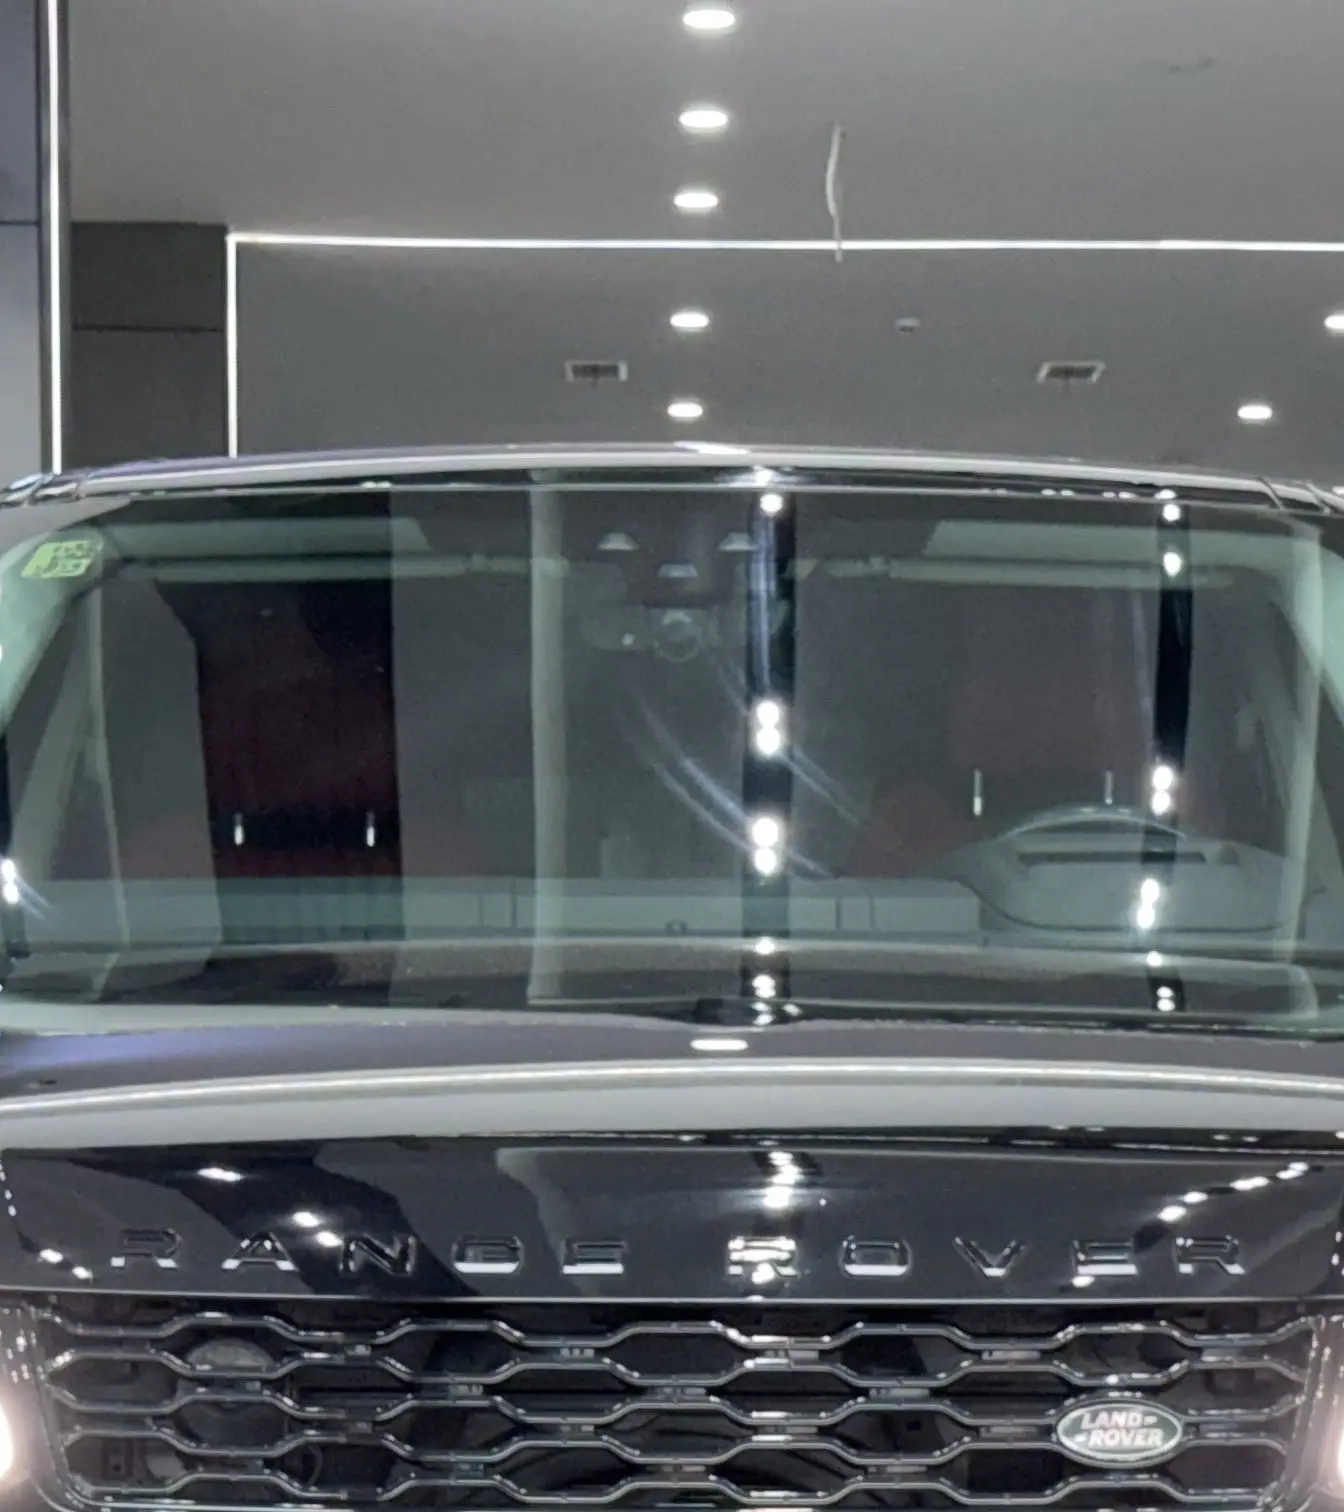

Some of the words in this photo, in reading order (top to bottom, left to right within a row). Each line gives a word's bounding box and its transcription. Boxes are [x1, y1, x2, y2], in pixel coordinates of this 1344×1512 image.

[110, 1228, 628, 1275] RANGE
[727, 1235, 1246, 1278] ROVER
[1087, 1428, 1165, 1447] ROVER
